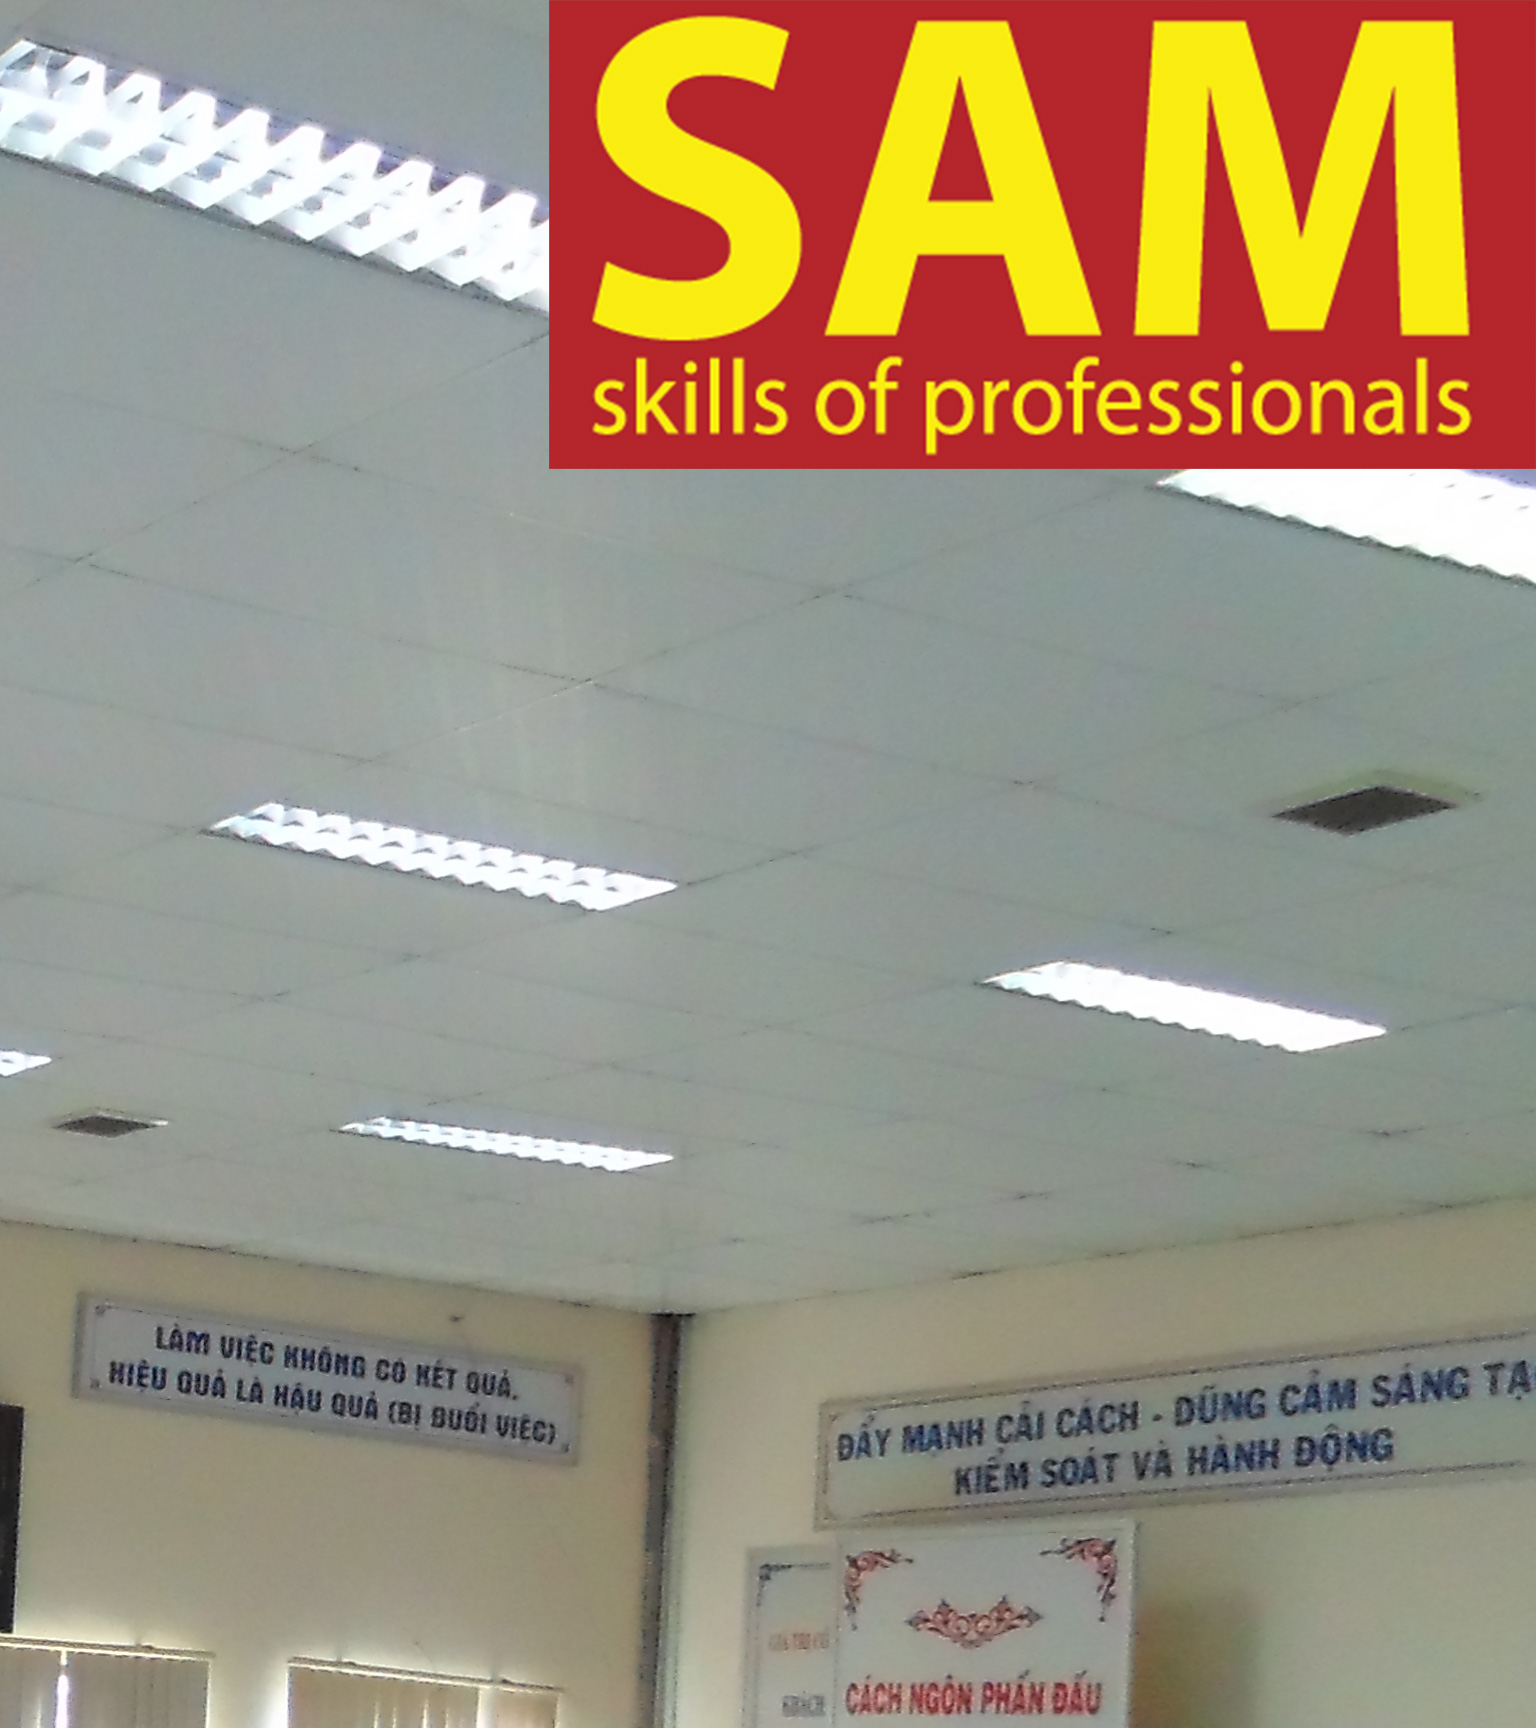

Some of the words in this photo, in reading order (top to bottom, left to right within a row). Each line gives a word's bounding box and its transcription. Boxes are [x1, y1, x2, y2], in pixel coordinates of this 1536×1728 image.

[155, 1322, 210, 1356] LÀM
[220, 1334, 275, 1368] VIỆC
[284, 1345, 366, 1379] KHÔNG
[108, 1358, 167, 1394] HIỆU
[177, 1367, 226, 1399] QUẢ
[236, 1375, 264, 1404] LÀ
[274, 1382, 322, 1415] HẬU
[331, 1390, 378, 1421] QUẢ
[901, 1417, 984, 1457] MẠNH
[995, 1400, 1045, 1445] CẢI
[1055, 1397, 1140, 1438] CÁCH
[1173, 1385, 1267, 1428] DŨNG
[1278, 1368, 1358, 1418] CẢM
[1371, 1362, 1471, 1408] SÁNG
[1482, 1359, 1536, 1401] TẠ
[954, 1447, 1030, 1496] KIỂM
[1040, 1446, 1121, 1488] SOÁT
[1132, 1439, 1173, 1481] VÀ
[1186, 1434, 1281, 1477] HÀNH
[1294, 1422, 1396, 1472] ĐỘNG
[845, 1673, 903, 1716] CÁCH
[909, 1672, 973, 1716] NGÔN
[980, 1668, 1045, 1716] PHẤN
[1051, 1669, 1103, 1716] ĐẤU
